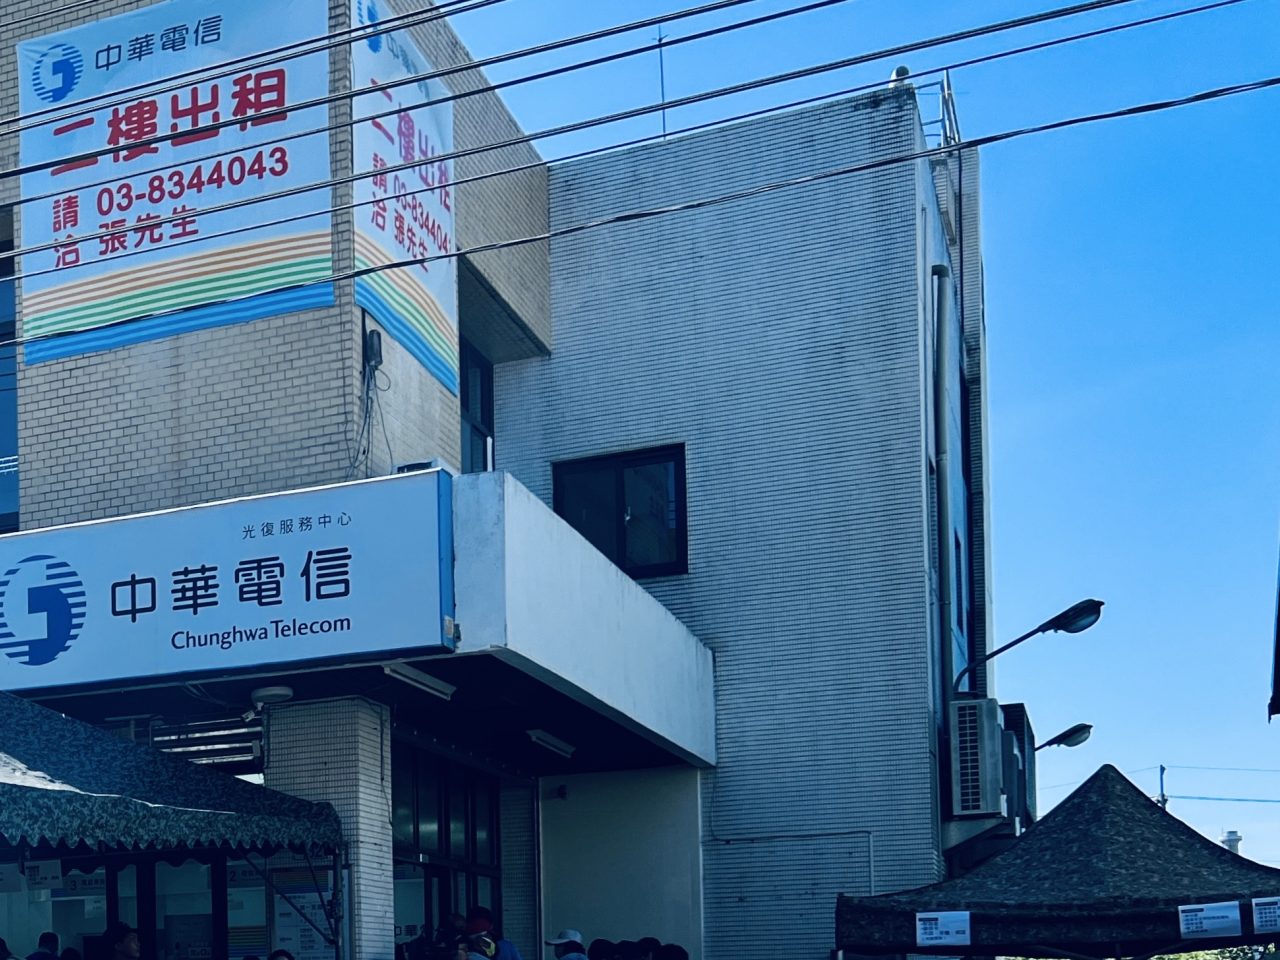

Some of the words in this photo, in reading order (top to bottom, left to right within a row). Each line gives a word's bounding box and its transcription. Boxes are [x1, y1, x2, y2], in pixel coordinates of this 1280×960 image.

[94, 13, 224, 72] 中華電信
[51, 67, 288, 177] 二樓出租
[97, 146, 289, 217] 03-8344043
[99, 205, 199, 257] 張先生
[394, 174, 451, 262] 03-834404
[241, 511, 353, 541] 光復服務中心
[110, 546, 352, 624] 中華電信
[171, 623, 269, 651] Chunghwa
[271, 615, 352, 641] Telecom
